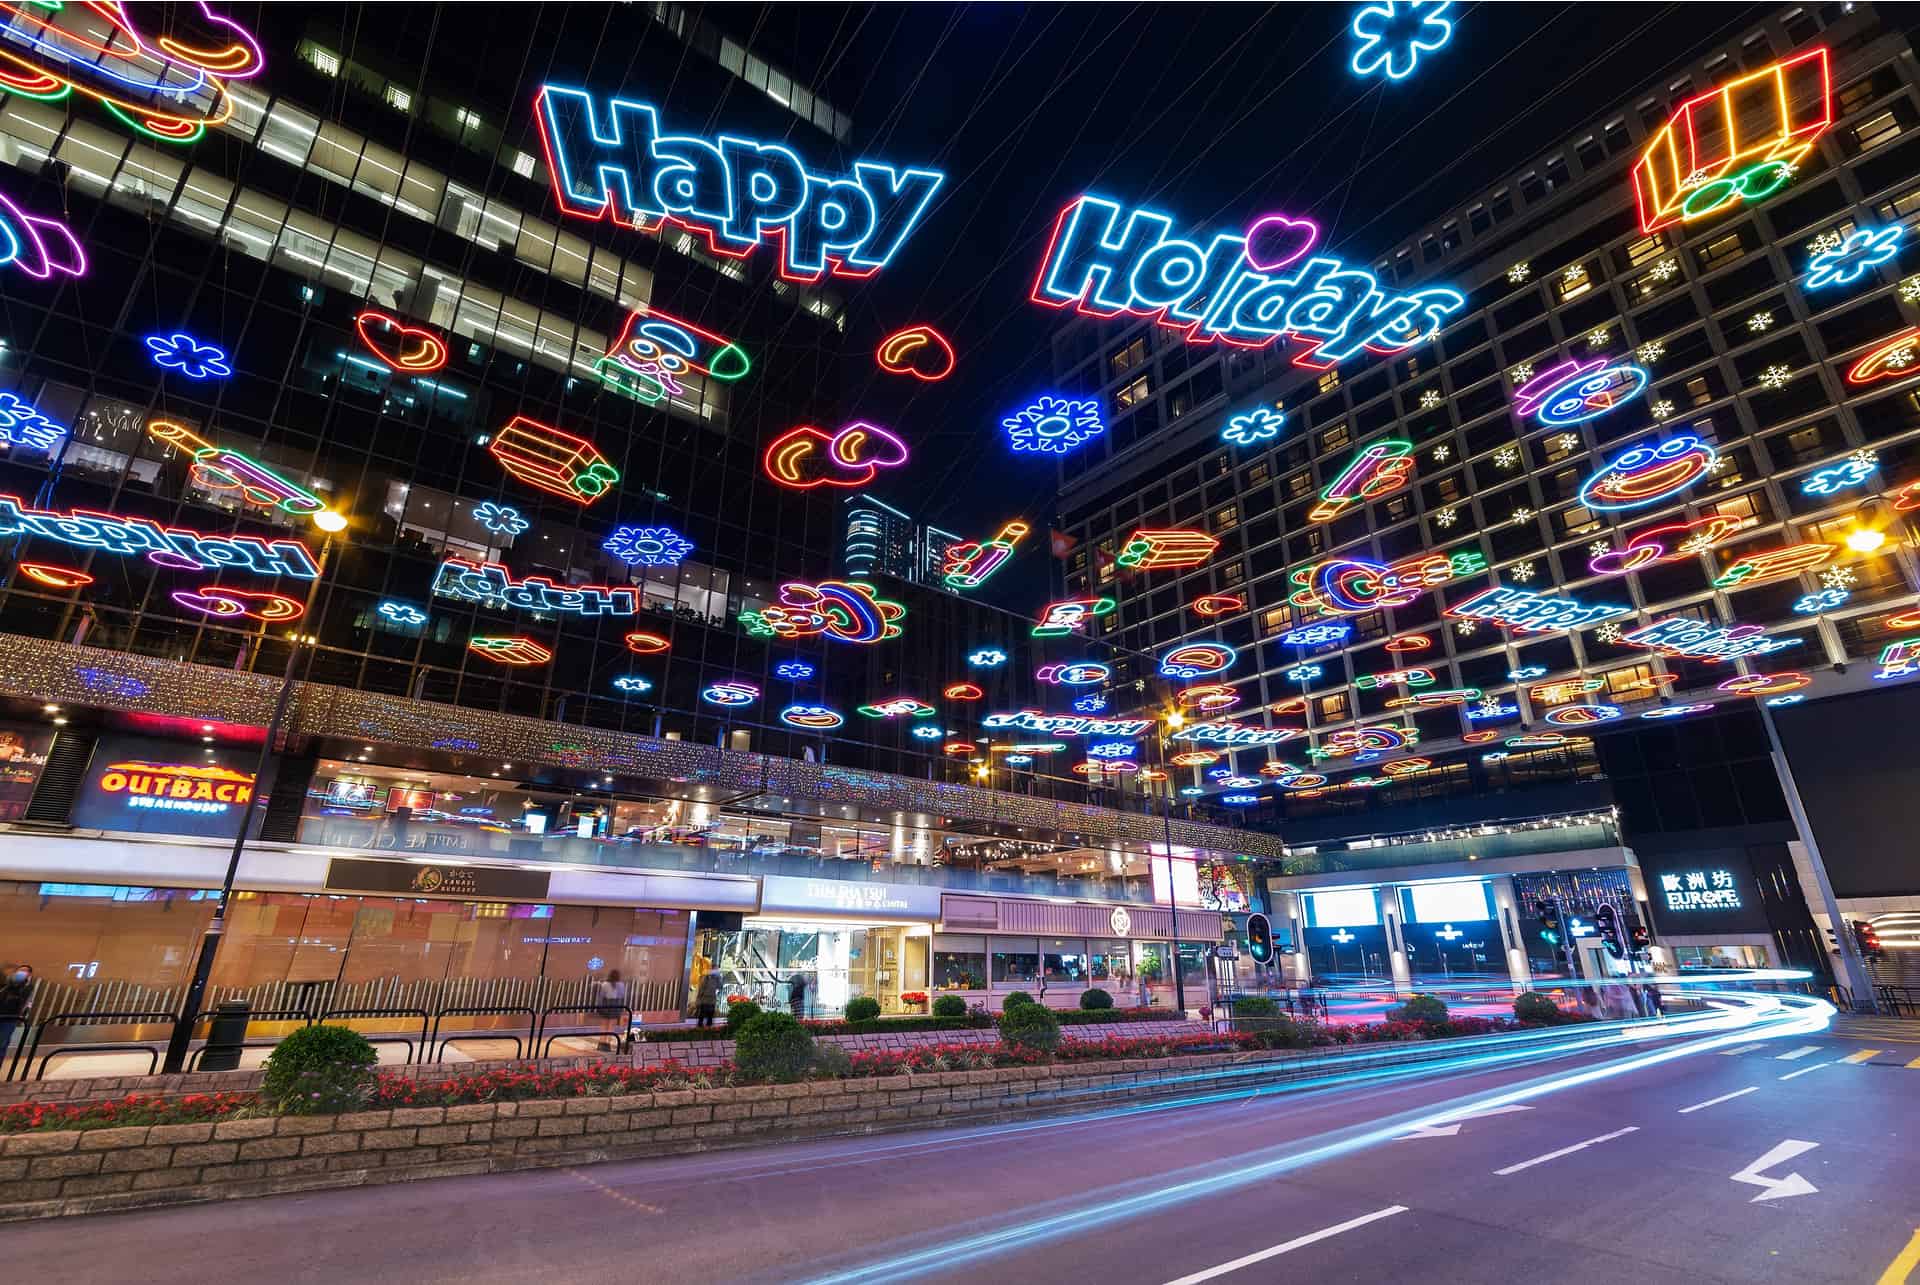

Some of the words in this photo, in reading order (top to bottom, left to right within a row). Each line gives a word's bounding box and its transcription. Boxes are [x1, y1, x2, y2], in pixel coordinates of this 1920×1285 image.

[536, 84, 944, 282] Happy
[1031, 194, 1465, 369] Holidays
[432, 558, 640, 615] Happy
[1443, 586, 1633, 633] Happy
[101, 773, 252, 803] OUTBACK
[1666, 889, 1738, 905] EUROPE
